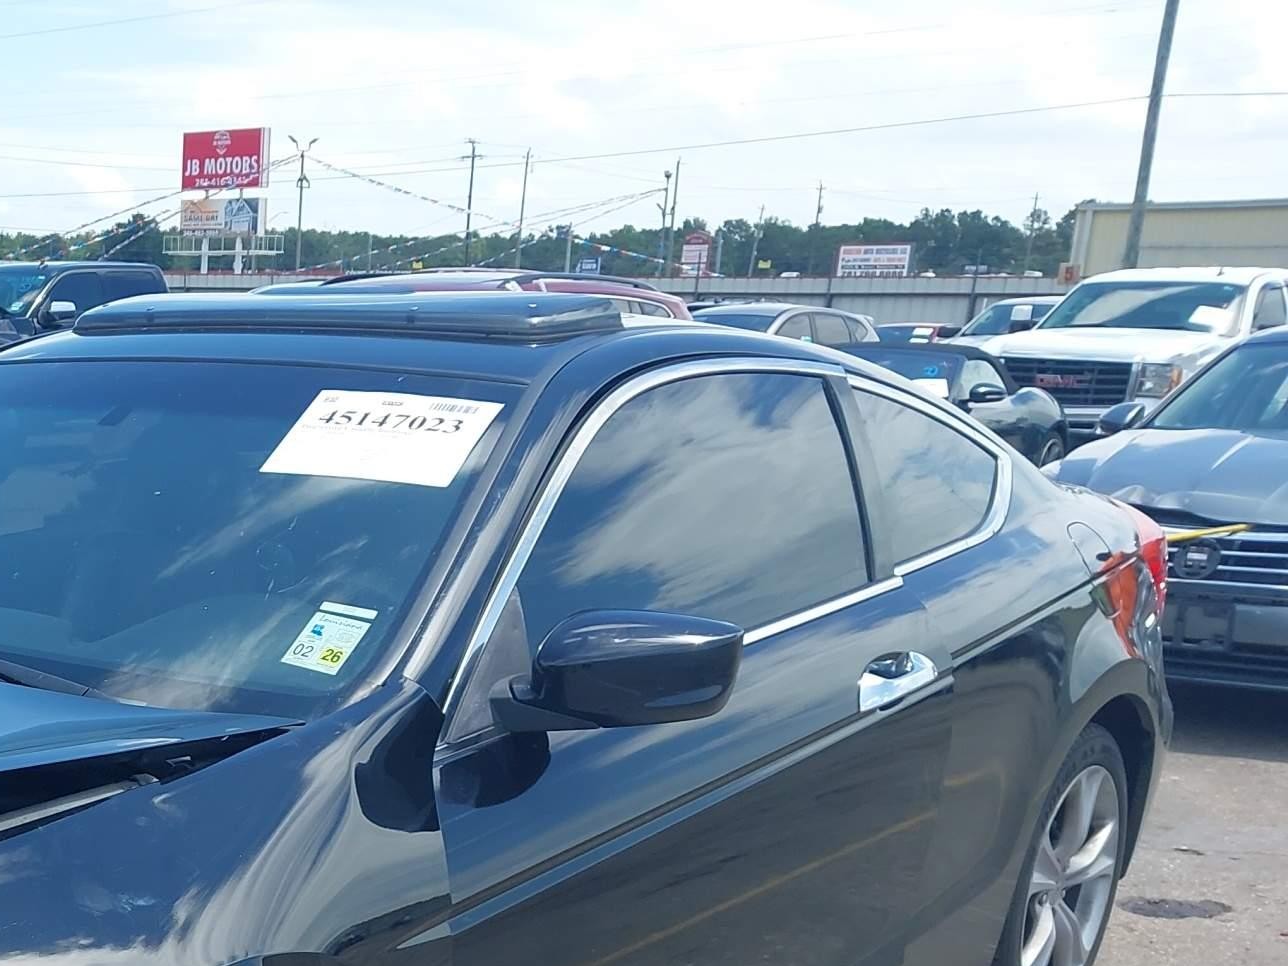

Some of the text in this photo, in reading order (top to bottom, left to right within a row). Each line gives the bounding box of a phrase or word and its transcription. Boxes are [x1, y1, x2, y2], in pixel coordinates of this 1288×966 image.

[184, 155, 258, 176] JB MOTORS
[318, 409, 464, 434] 45147023
[292, 642, 343, 663] 02 26
